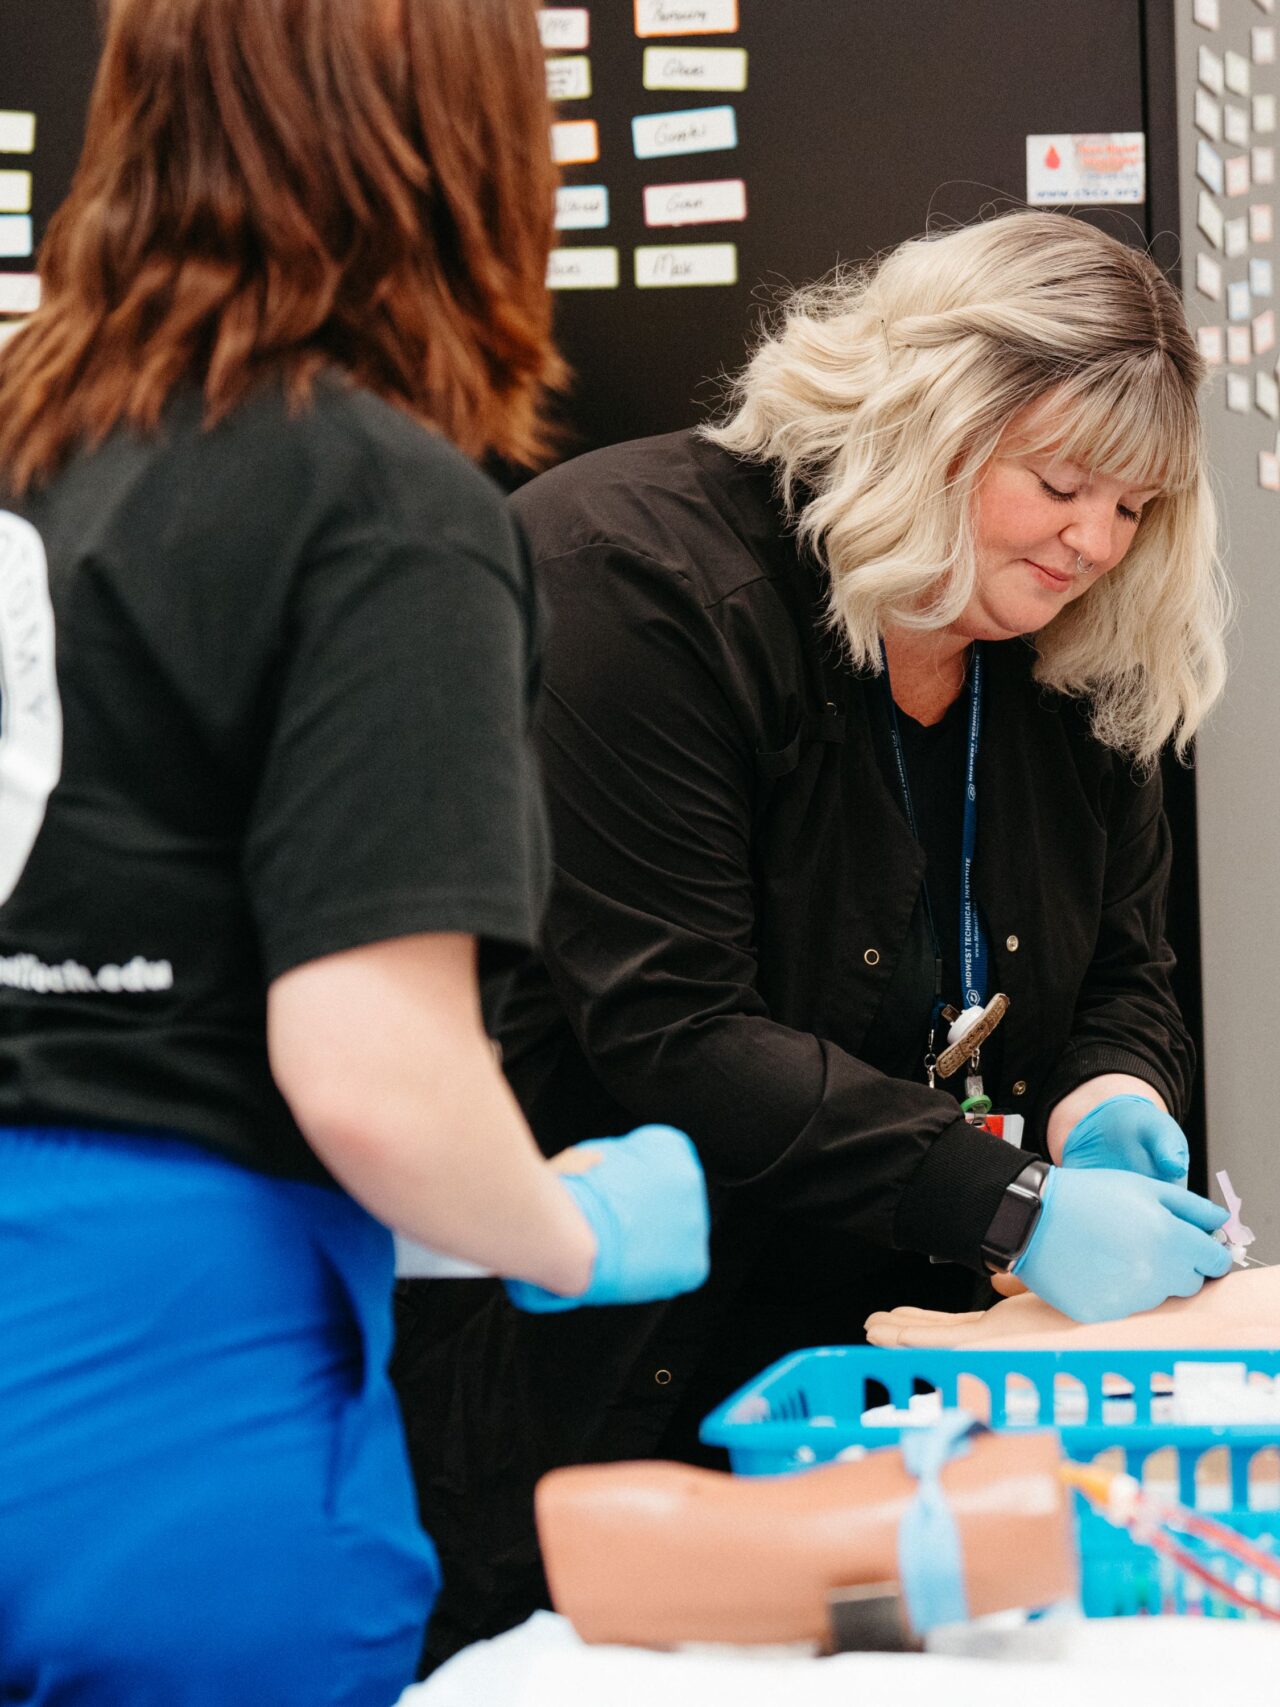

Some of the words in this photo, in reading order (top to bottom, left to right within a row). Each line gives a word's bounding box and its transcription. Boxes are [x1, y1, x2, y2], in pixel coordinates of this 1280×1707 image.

[970, 696, 978, 741] TECHNICAL
[964, 901, 972, 946] TECHNICAL
[964, 948, 972, 988] MIDWEST
